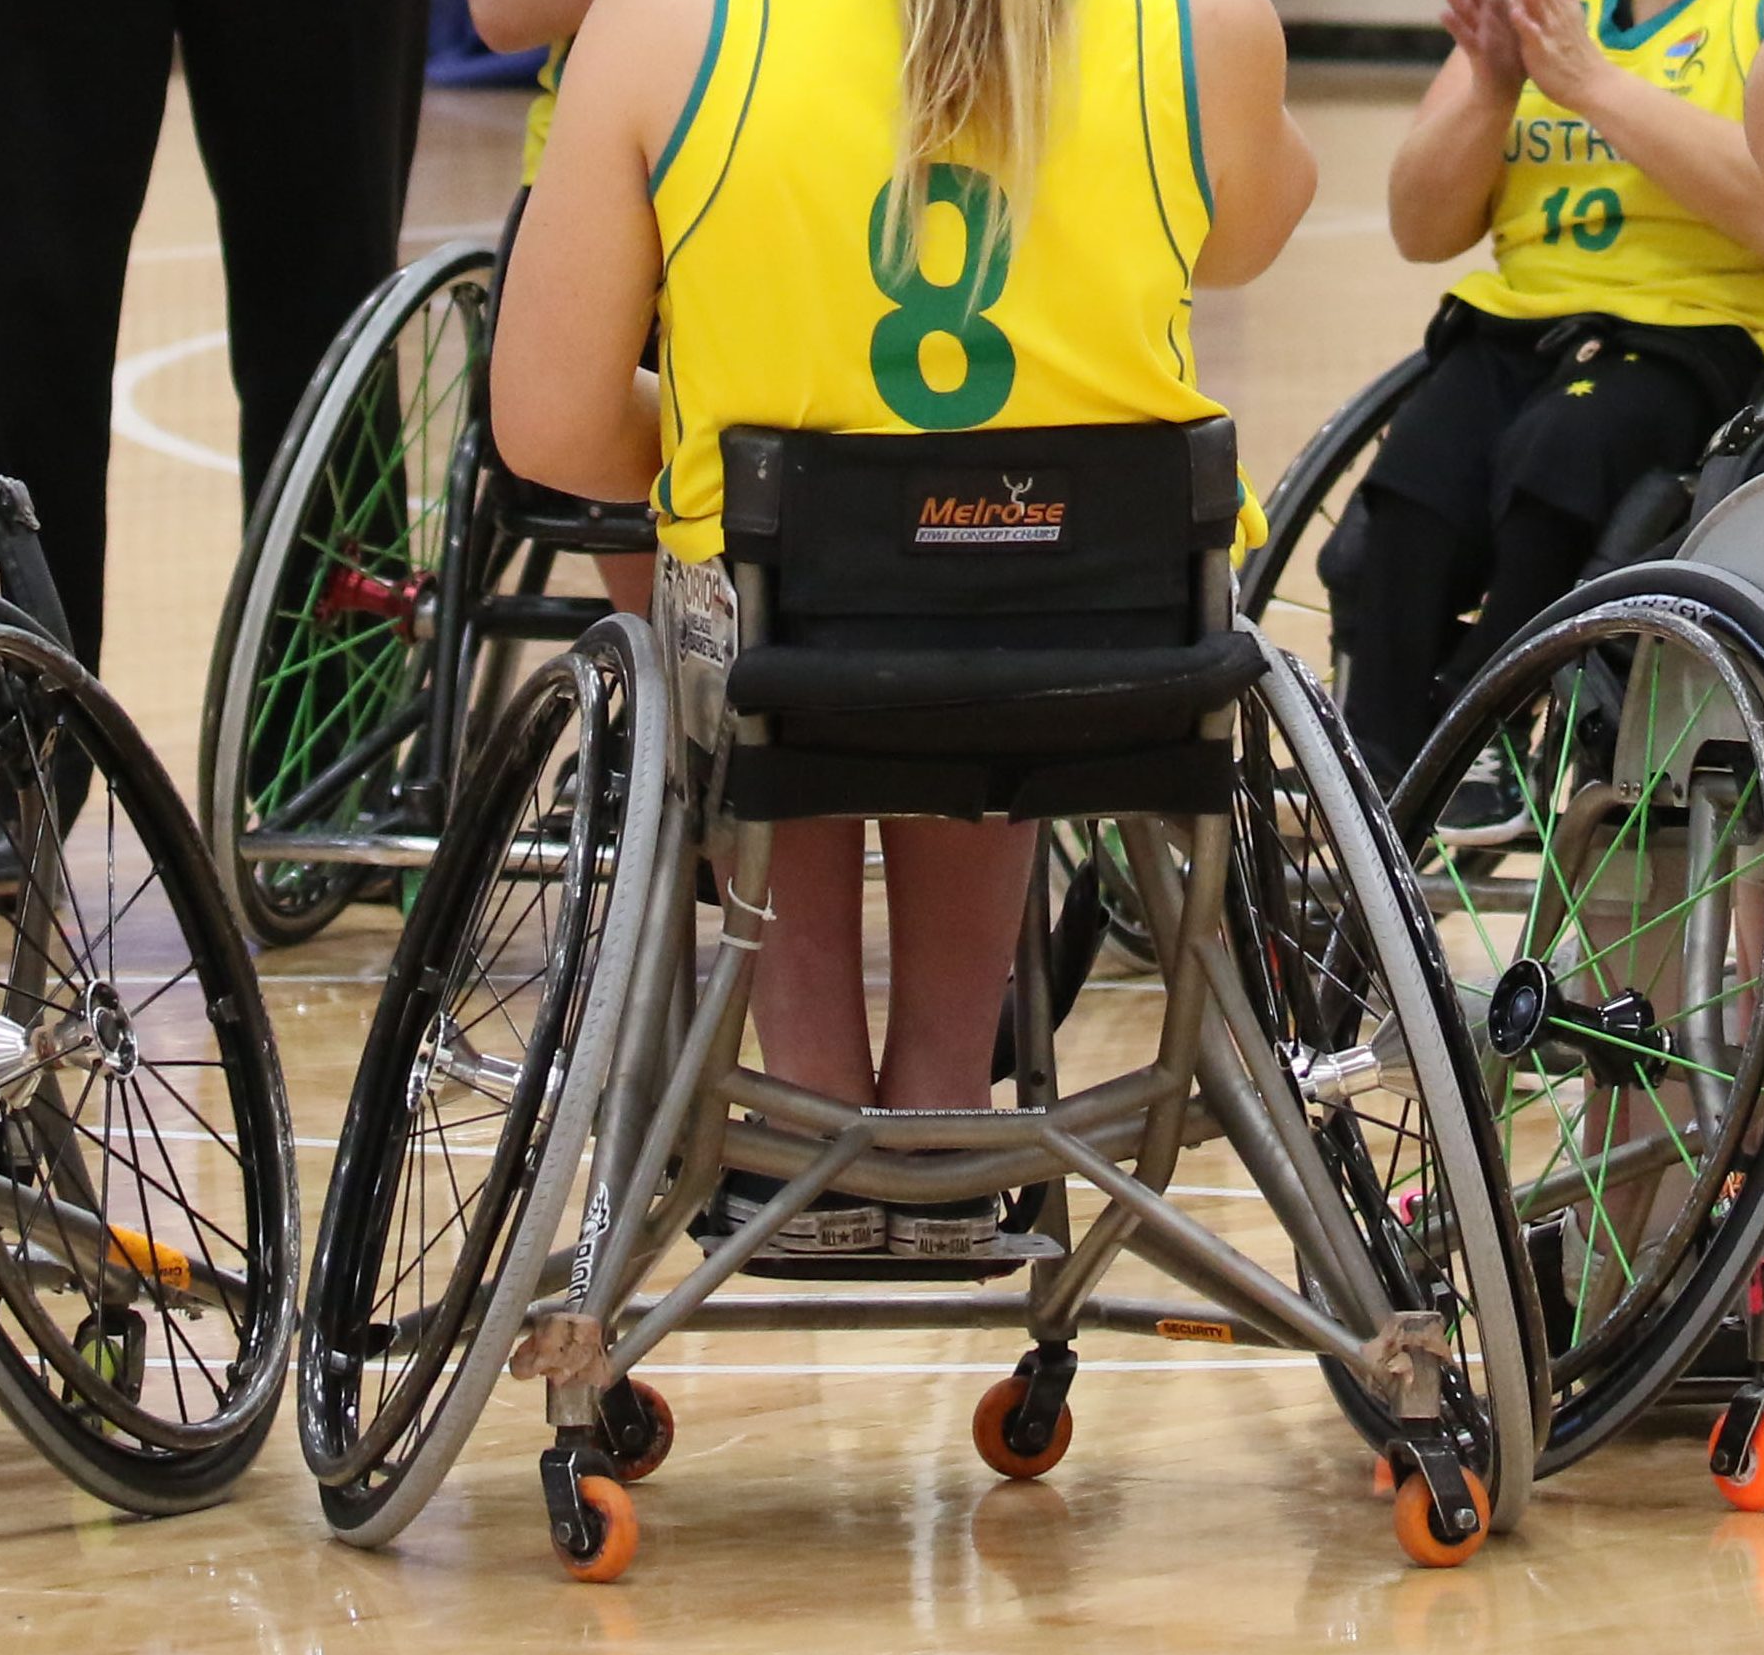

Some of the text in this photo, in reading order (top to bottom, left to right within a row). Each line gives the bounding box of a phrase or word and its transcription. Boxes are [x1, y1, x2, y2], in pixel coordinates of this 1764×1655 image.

[867, 162, 1017, 430] 8
[919, 497, 1065, 525] Melrose
[952, 529, 1009, 540] CONCEPT
[1013, 528, 1058, 539] CHAIRS
[1164, 1323, 1223, 1337] SECURITY
